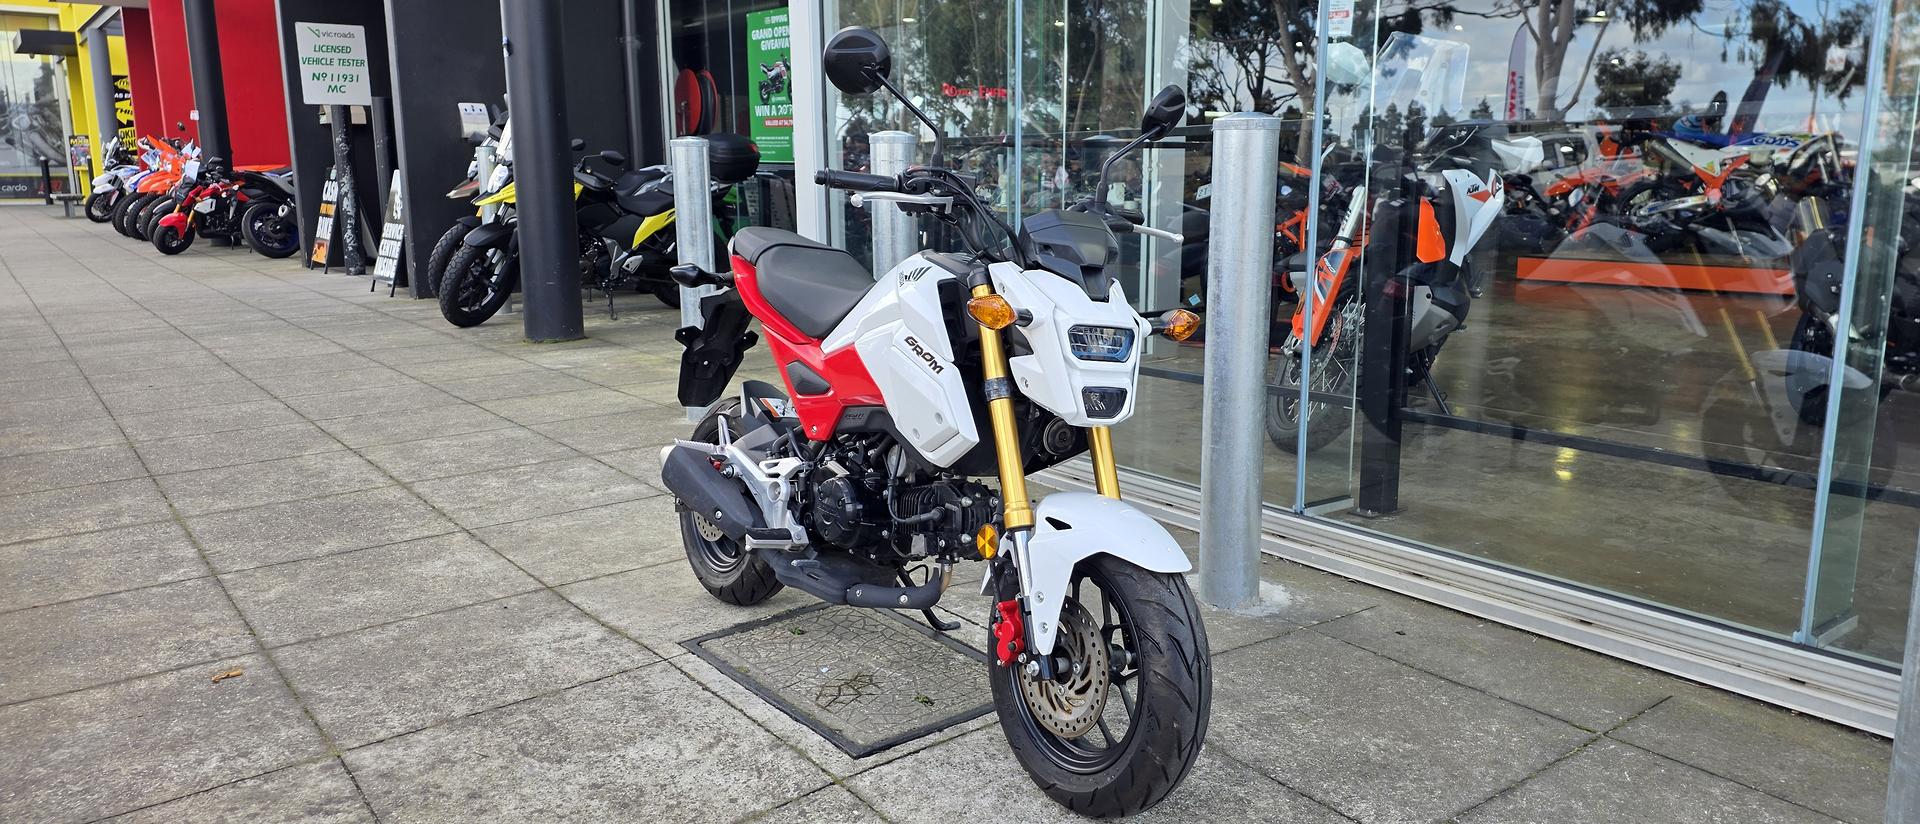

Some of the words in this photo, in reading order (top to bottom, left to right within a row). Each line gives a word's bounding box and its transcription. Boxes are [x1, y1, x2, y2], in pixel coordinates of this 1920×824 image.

[321, 30, 355, 38] vicroads
[752, 28, 772, 40] GRAND
[313, 44, 352, 54] LICENSED
[761, 37, 791, 50] GIVEAWA
[301, 56, 335, 67] VEHICLE
[337, 58, 366, 67] TESTER
[331, 73, 360, 83] 11931
[327, 84, 347, 94] MC
[755, 104, 770, 117] WIN
[771, 104, 777, 116] A
[1, 183, 28, 191] cardo
[1467, 184, 1480, 195] KTM
[382, 222, 405, 240] SERVICE
[378, 239, 401, 259] CENTRE
[904, 335, 945, 375] GROM
